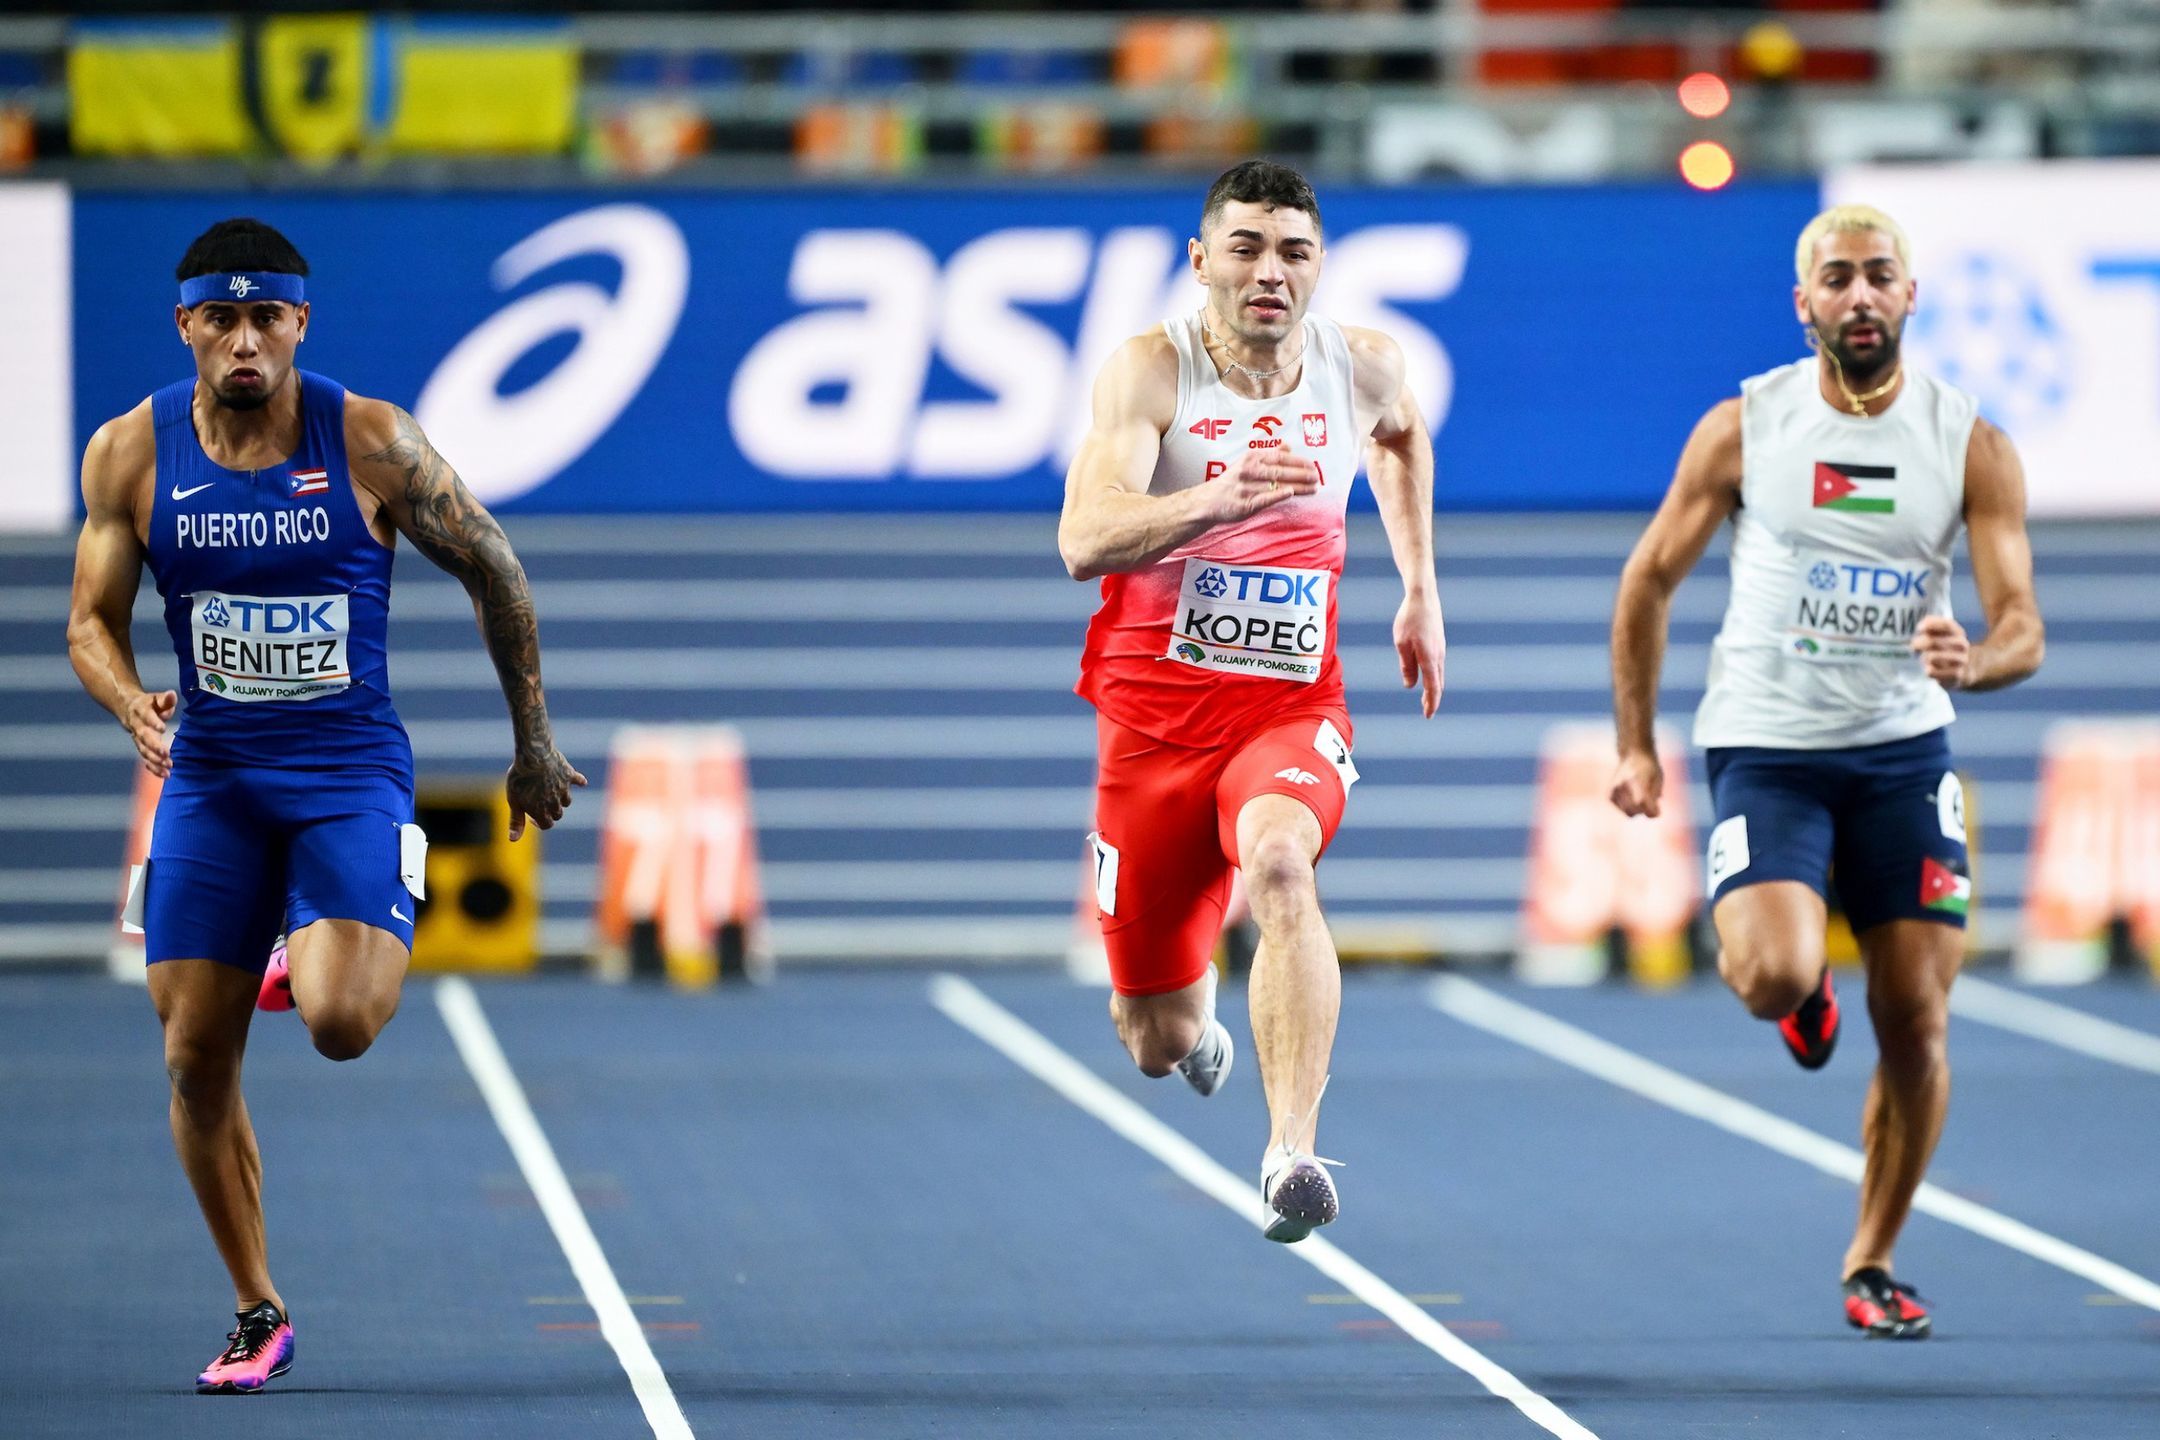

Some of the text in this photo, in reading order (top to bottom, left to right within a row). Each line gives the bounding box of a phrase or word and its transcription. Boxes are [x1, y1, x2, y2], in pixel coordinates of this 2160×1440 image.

[1188, 417, 1233, 441] 4F
[176, 506, 330, 549] PUERTO RICO
[1229, 570, 1321, 607] TDK
[1841, 563, 1931, 598] TDK
[229, 600, 336, 634] TDK
[1184, 608, 1319, 653] KOPEĆ
[201, 633, 338, 675] BENITEZ
[1213, 654, 1256, 667] KUJAWY
[1257, 659, 1308, 674] POMORZE
[233, 684, 274, 697] KUJAWY
